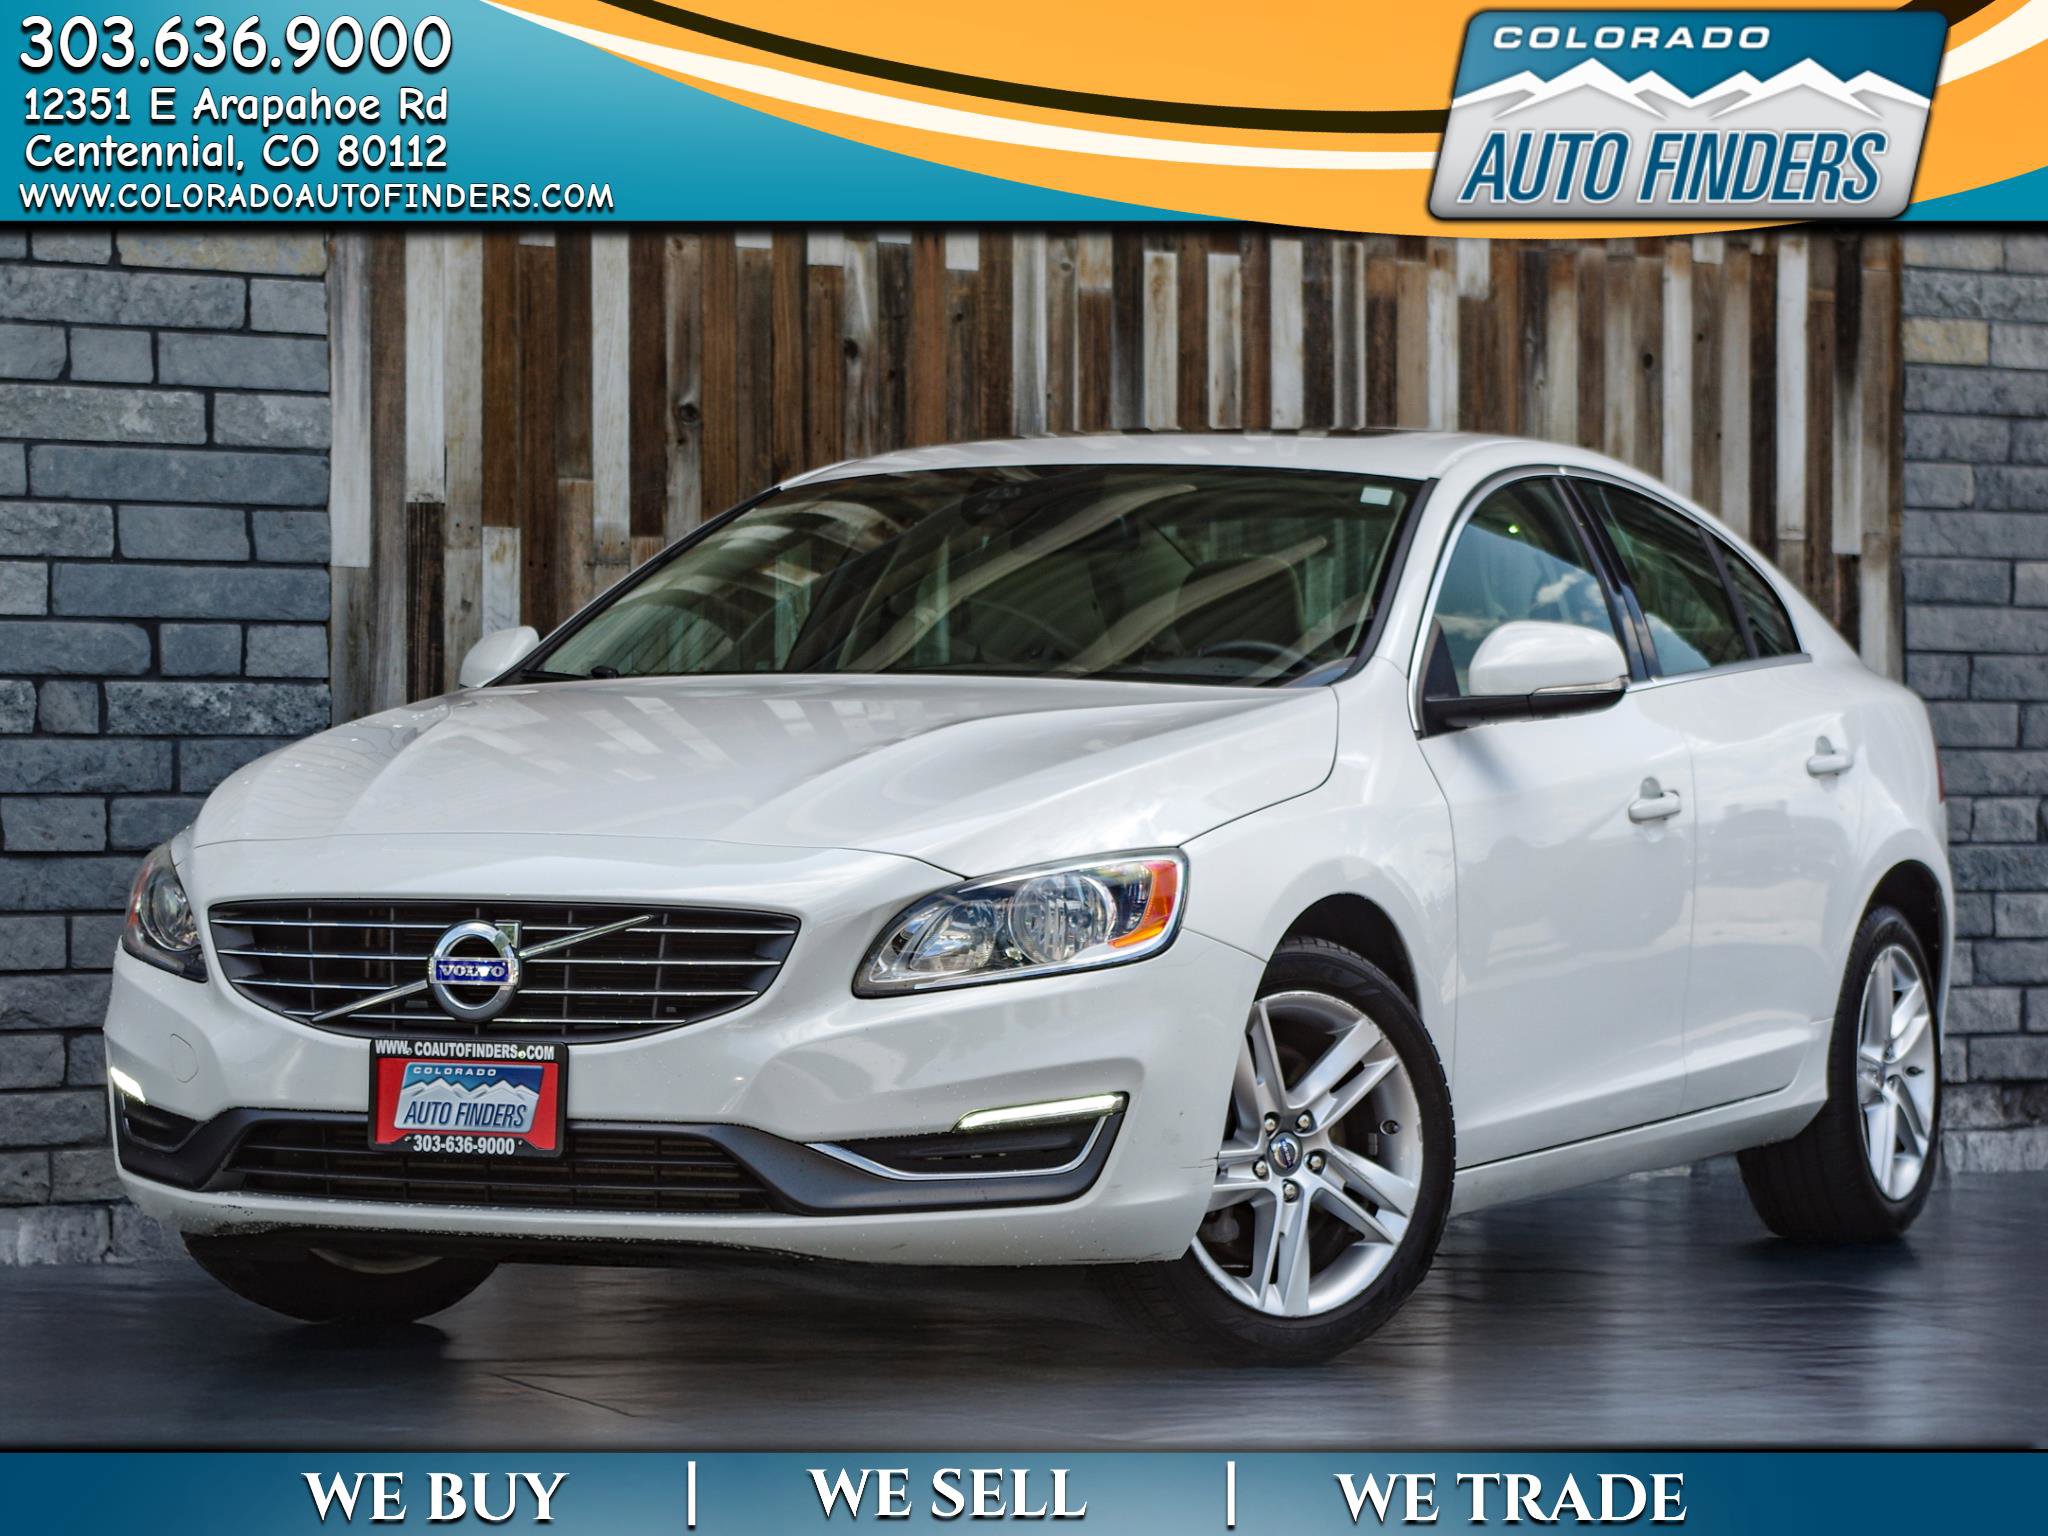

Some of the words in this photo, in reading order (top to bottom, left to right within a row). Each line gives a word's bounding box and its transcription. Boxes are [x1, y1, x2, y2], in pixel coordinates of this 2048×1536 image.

[438, 964, 505, 977] VOLVO
[413, 1067, 496, 1077] COLORADO
[403, 1101, 451, 1125] AUTO
[455, 1103, 528, 1128] FINDERS
[413, 1135, 515, 1155] 303-636-9000
